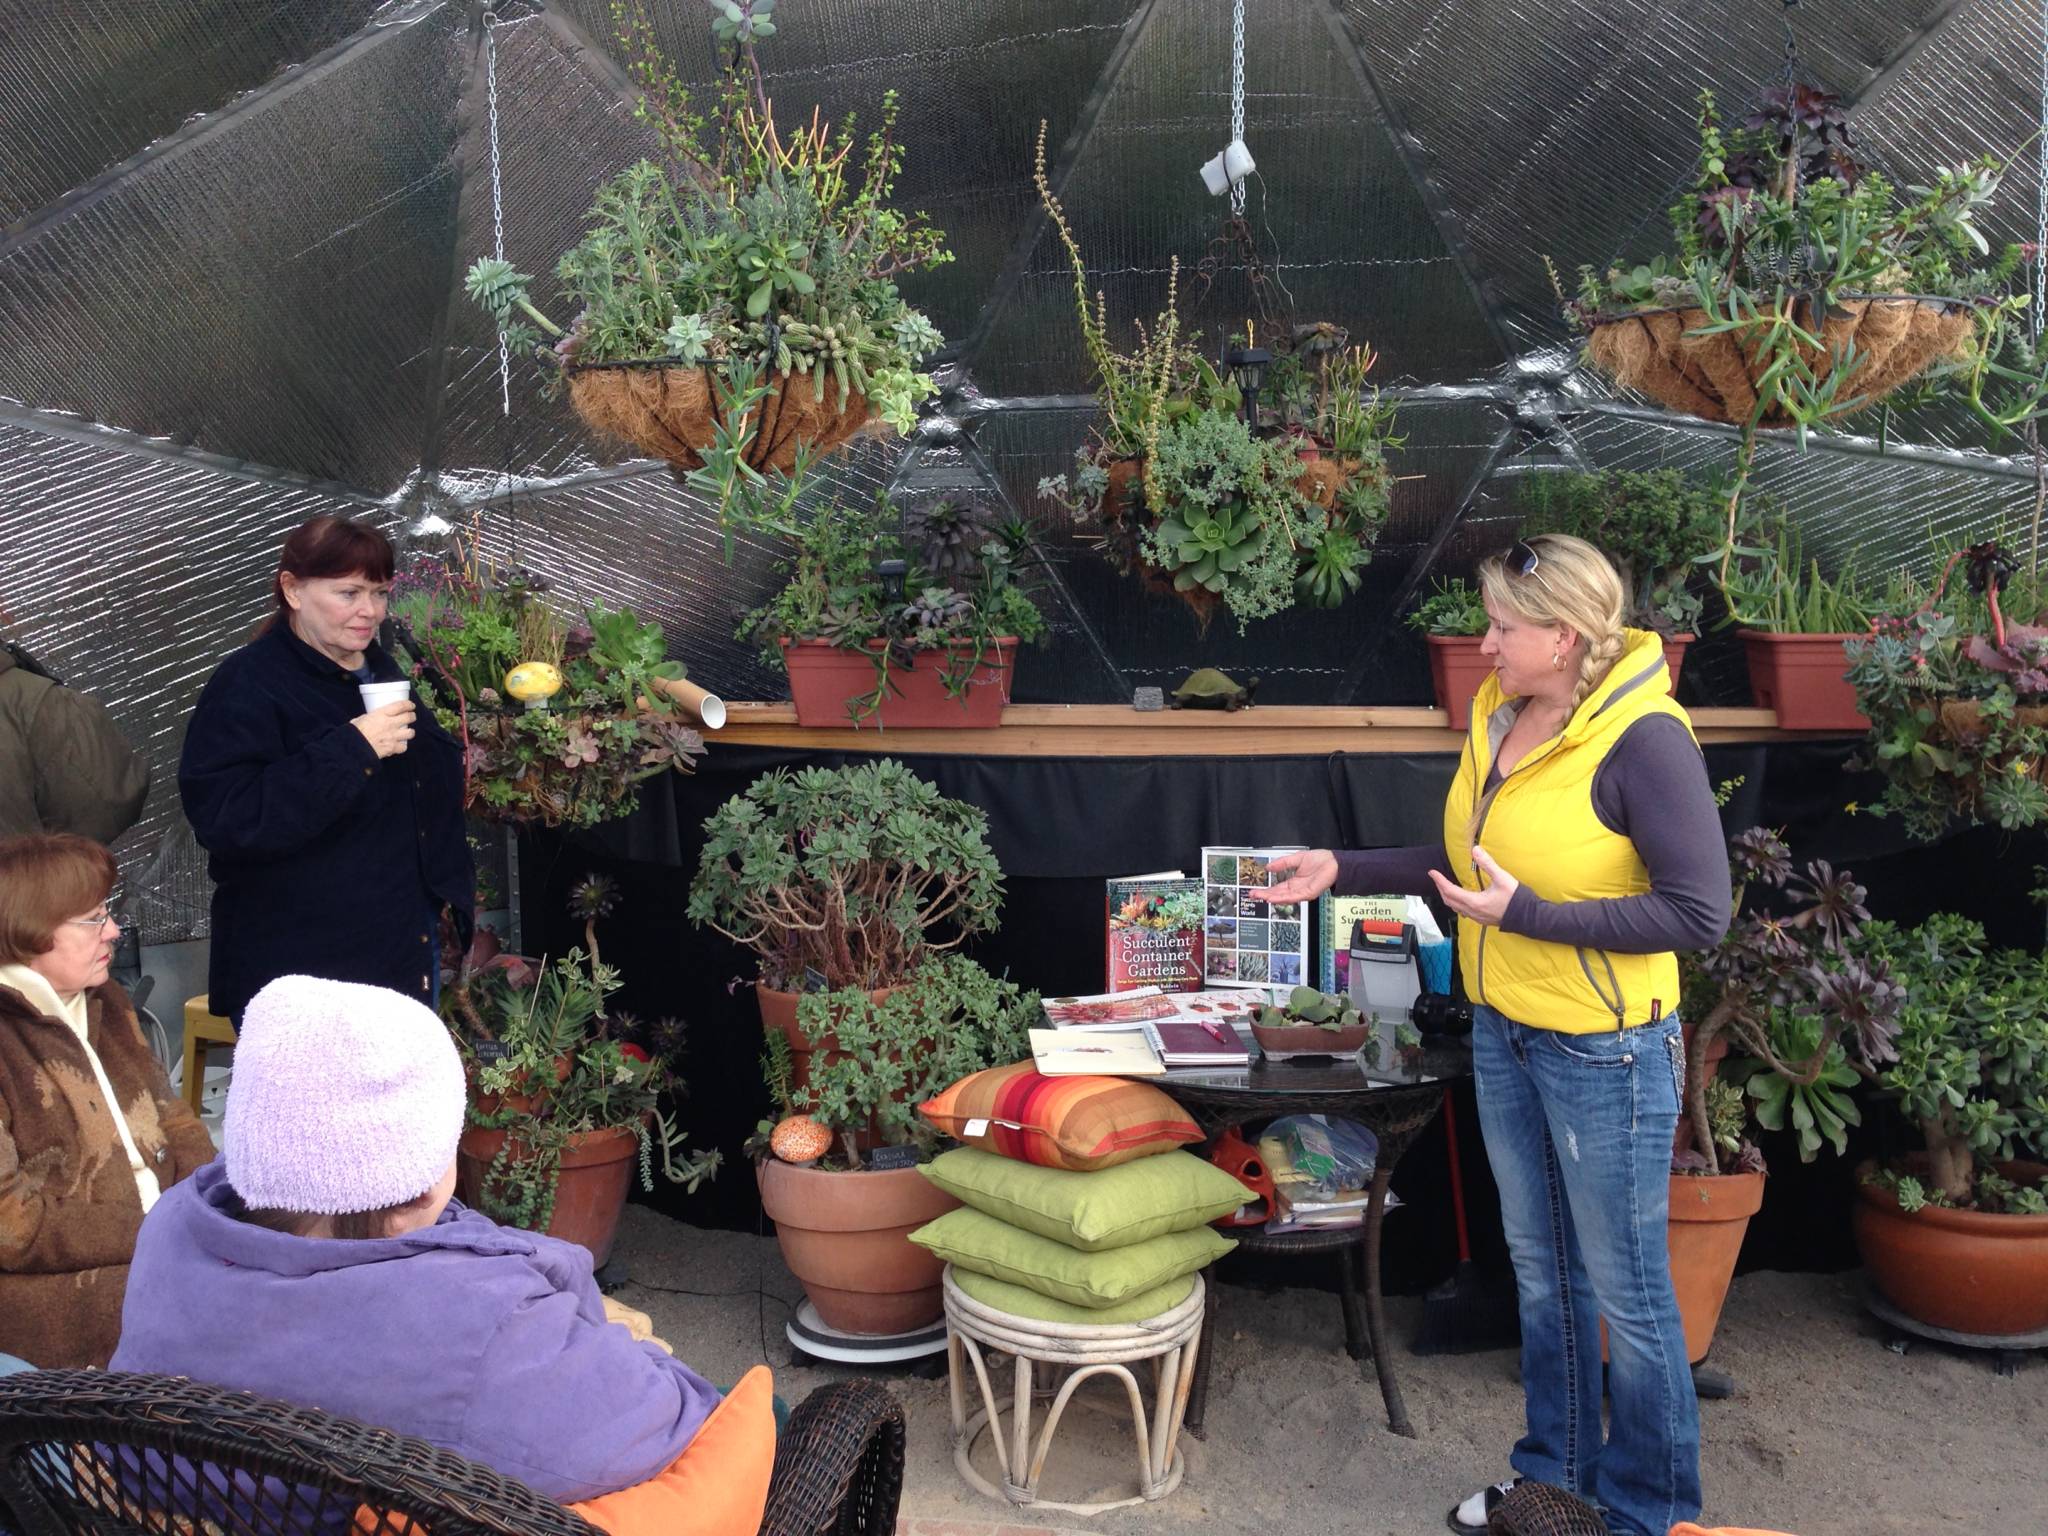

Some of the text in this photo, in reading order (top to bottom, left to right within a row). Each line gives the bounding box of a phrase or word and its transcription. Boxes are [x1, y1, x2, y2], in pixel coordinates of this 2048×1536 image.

[1350, 906, 1392, 915] Garden
[1123, 935, 1190, 949] Succulent
[1122, 950, 1192, 963] Container
[1128, 963, 1186, 977] Gardens
